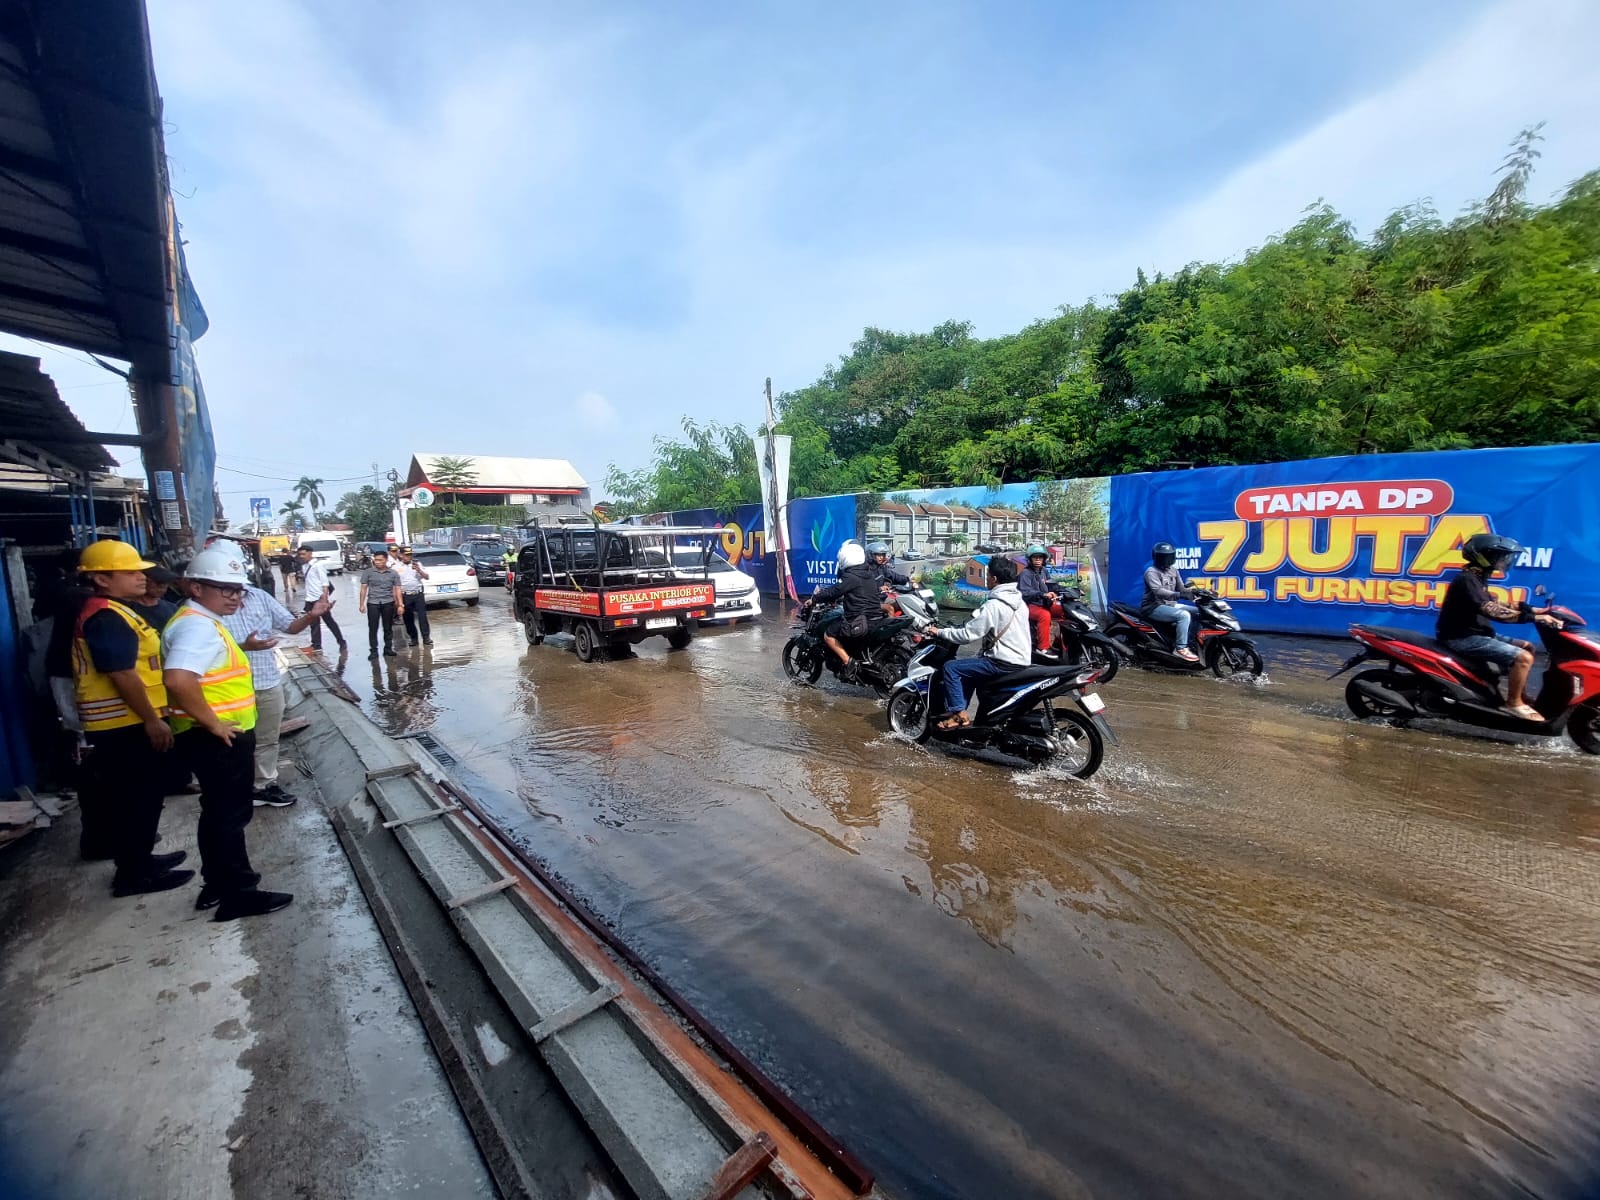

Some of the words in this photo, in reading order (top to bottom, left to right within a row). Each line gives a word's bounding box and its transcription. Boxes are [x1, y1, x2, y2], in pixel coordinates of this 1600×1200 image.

[1249, 489, 1365, 515] TANPA
[1378, 487, 1433, 509] DP
[1175, 547, 1202, 559] CILAN
[1514, 547, 1553, 568] AN
[609, 593, 648, 604] PUSAKA
[650, 587, 691, 600] INTERIOR
[693, 586, 710, 596] PVC
[1186, 576, 1268, 600] FULL
[1275, 576, 1528, 610] FURNISHD!
